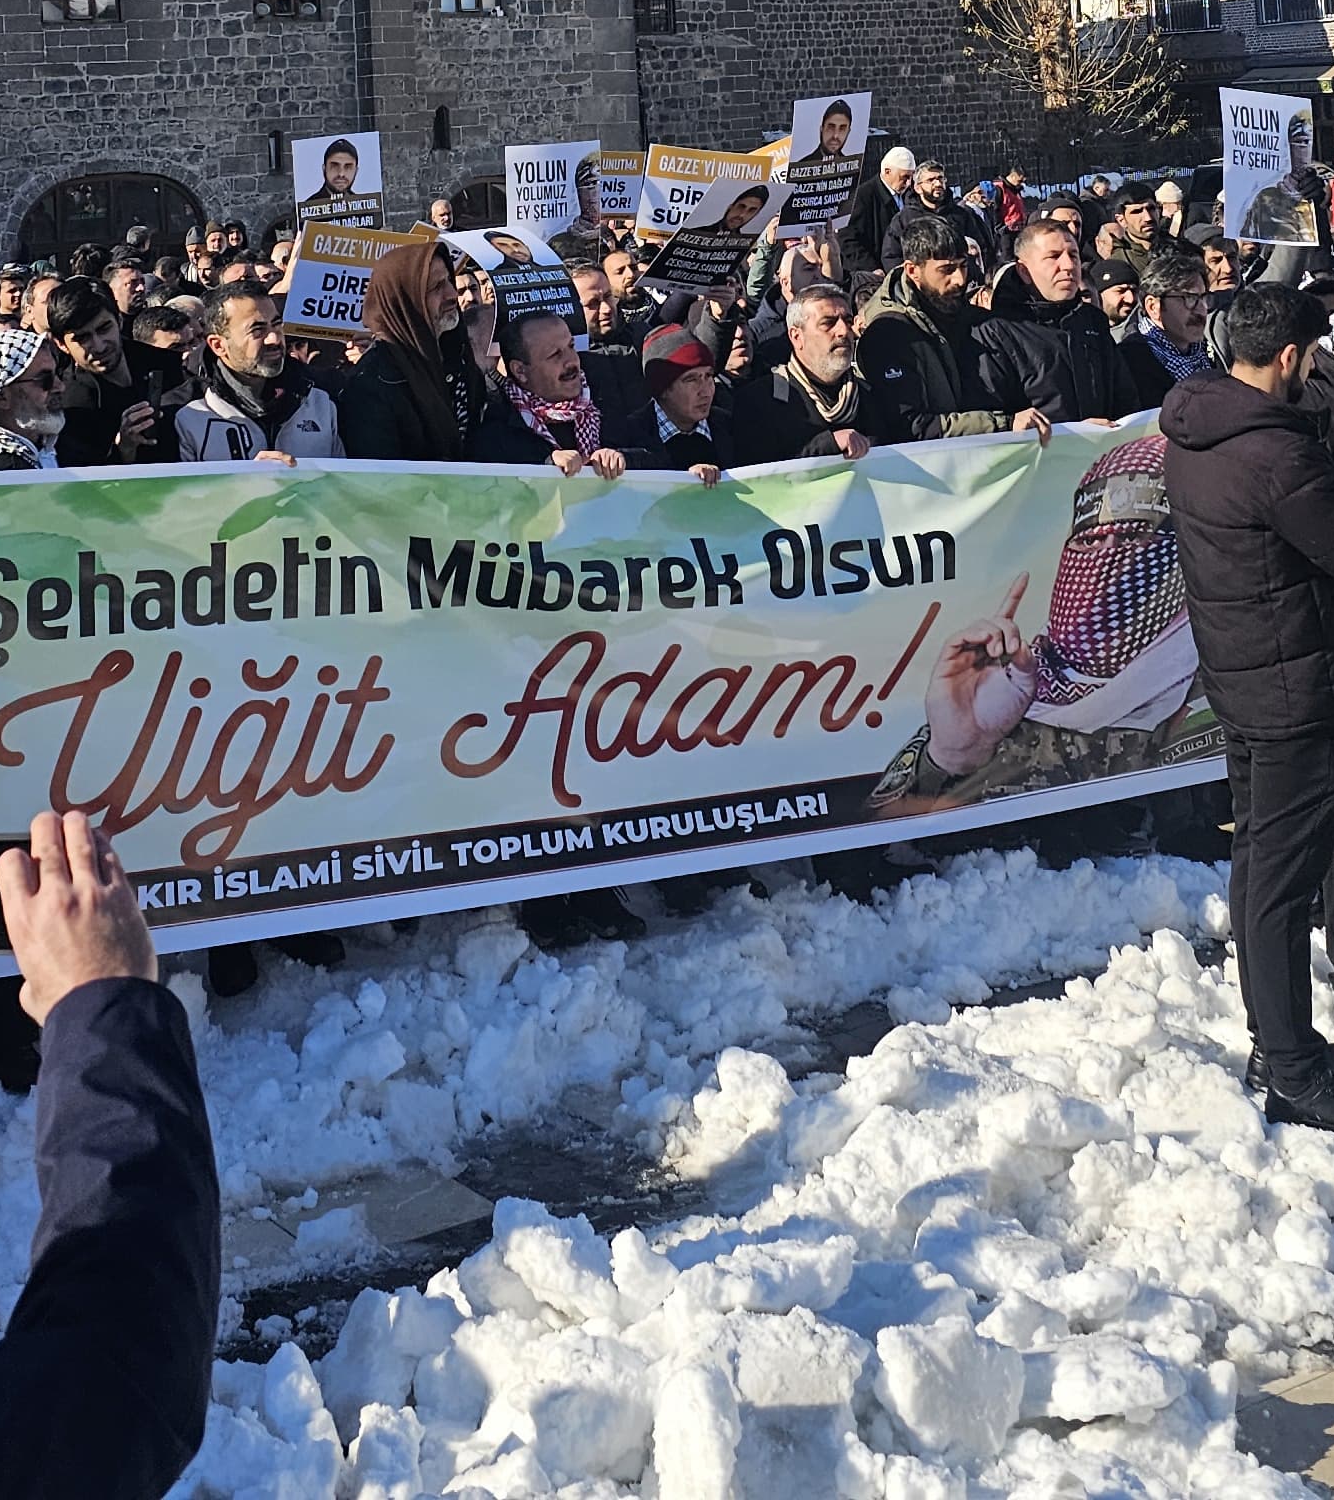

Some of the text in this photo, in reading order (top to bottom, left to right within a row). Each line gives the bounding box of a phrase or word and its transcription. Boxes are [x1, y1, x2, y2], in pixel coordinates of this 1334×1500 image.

[1229, 104, 1280, 134] YOLUN
[1232, 129, 1280, 151] YOLUMUZ
[513, 159, 567, 184] YOLUN
[601, 157, 638, 171] UNUTMA
[659, 155, 716, 177] GAZZE'Yİ
[717, 161, 763, 181] UNUTMA
[822, 162, 836, 174] DAĞ
[1233, 149, 1280, 171] EY ŞEHİT!
[516, 184, 567, 202] YOLUMUZ
[792, 191, 850, 208] CESURCA SAVAŞAN
[332, 200, 347, 214] DAĞ
[516, 200, 568, 221] EY ŞEHİT!
[313, 233, 373, 261] GAZZE'Yİ
[321, 270, 371, 296] DİRE
[300, 295, 364, 322] SÜRÜ
[405, 536, 744, 613] Mübarek
[762, 524, 957, 600] Olsun
[440, 600, 942, 808] Adam!
[213, 850, 342, 901] İSLAMİ
[352, 838, 444, 882] SİVİL
[449, 814, 595, 868] TOPLUM
[602, 791, 829, 848] KURULUŞLARI
